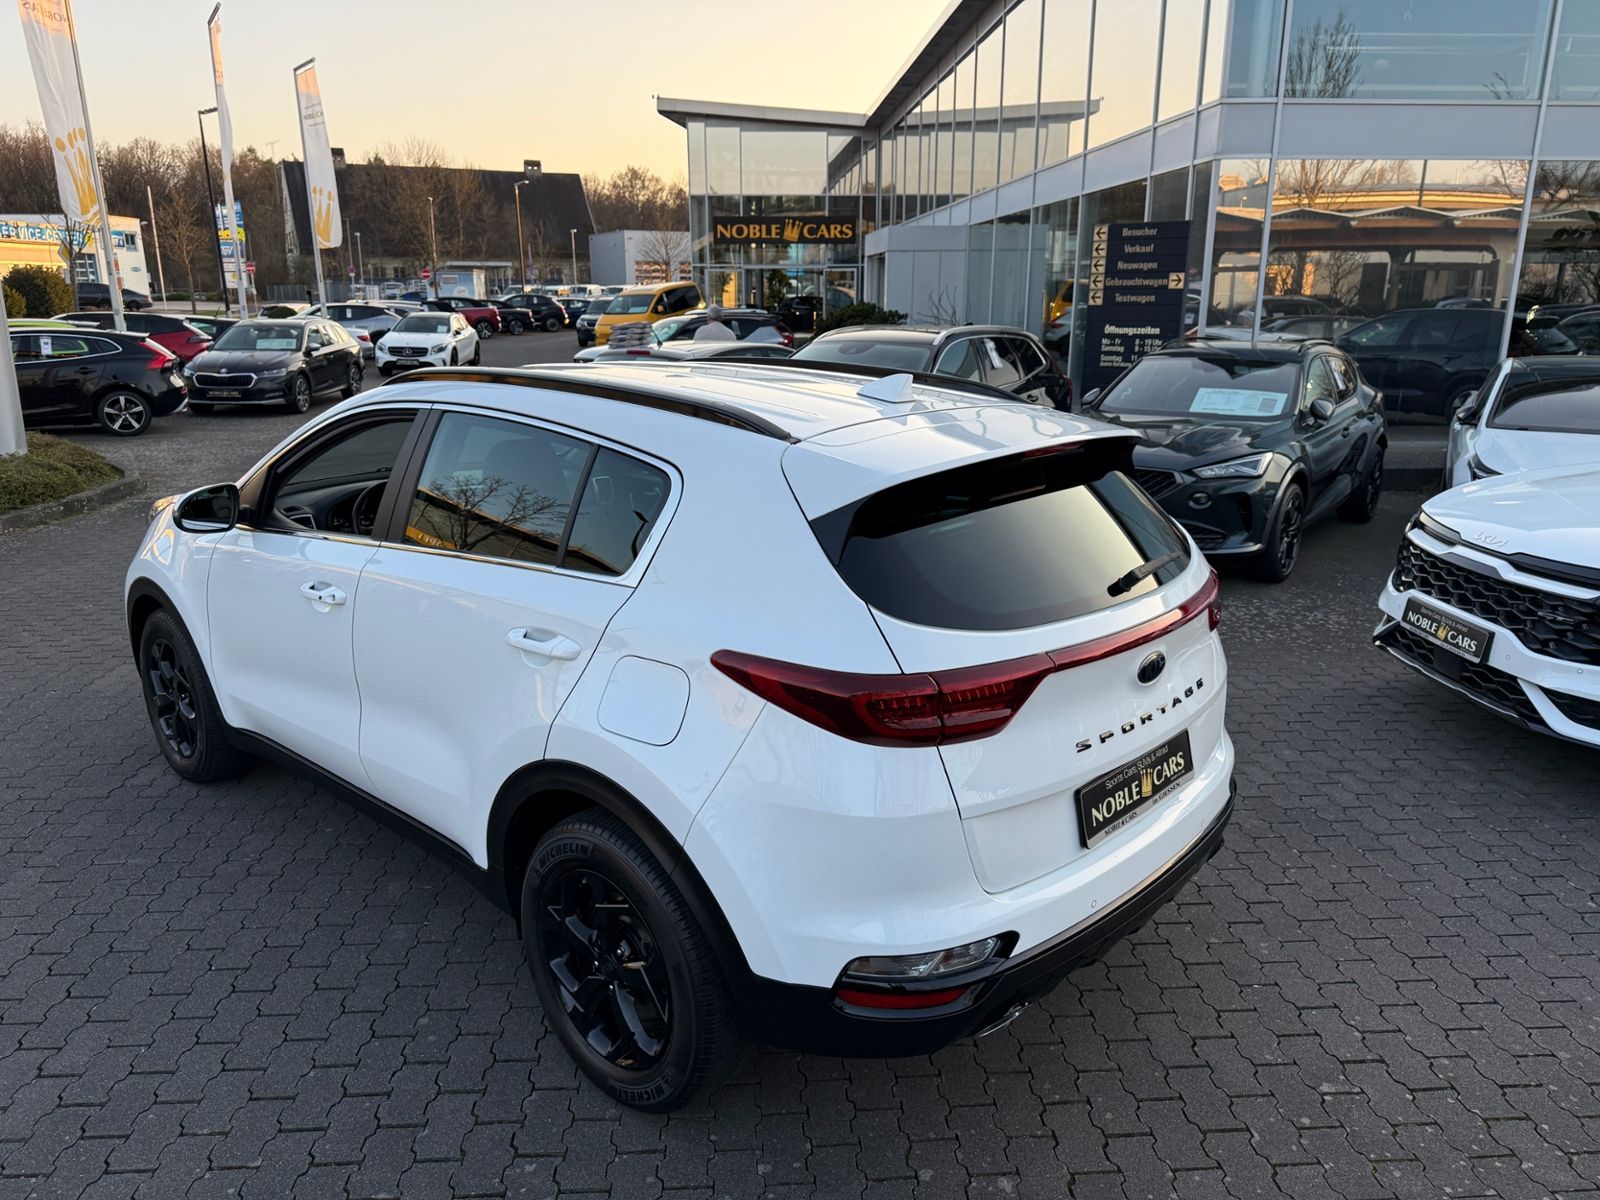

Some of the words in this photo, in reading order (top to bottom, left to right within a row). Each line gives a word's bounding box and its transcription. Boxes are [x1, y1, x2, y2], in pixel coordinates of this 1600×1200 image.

[716, 223, 781, 240] NOBLE
[802, 223, 854, 239] CARS
[1122, 227, 1158, 237] Besucher
[1124, 243, 1155, 253] Verkauf
[1117, 261, 1158, 271] Neuwagen
[1105, 277, 1168, 287] Gebrauchtwagen
[1115, 293, 1156, 303] Testwagen
[1104, 323, 1160, 336] Öffnungszeiten
[1152, 338, 1162, 346] Uhr
[1406, 610, 1438, 634] NOBLE
[1447, 631, 1478, 652] CARS
[1075, 677, 1204, 754] SPORTAGE
[1105, 774, 1124, 790] Sports
[1123, 765, 1137, 779] Cars
[1091, 781, 1141, 827] NOBLE
[1153, 752, 1185, 785] CARS
[1104, 821, 1121, 837] NOBLE
[540, 841, 590, 868] MICHELIN
